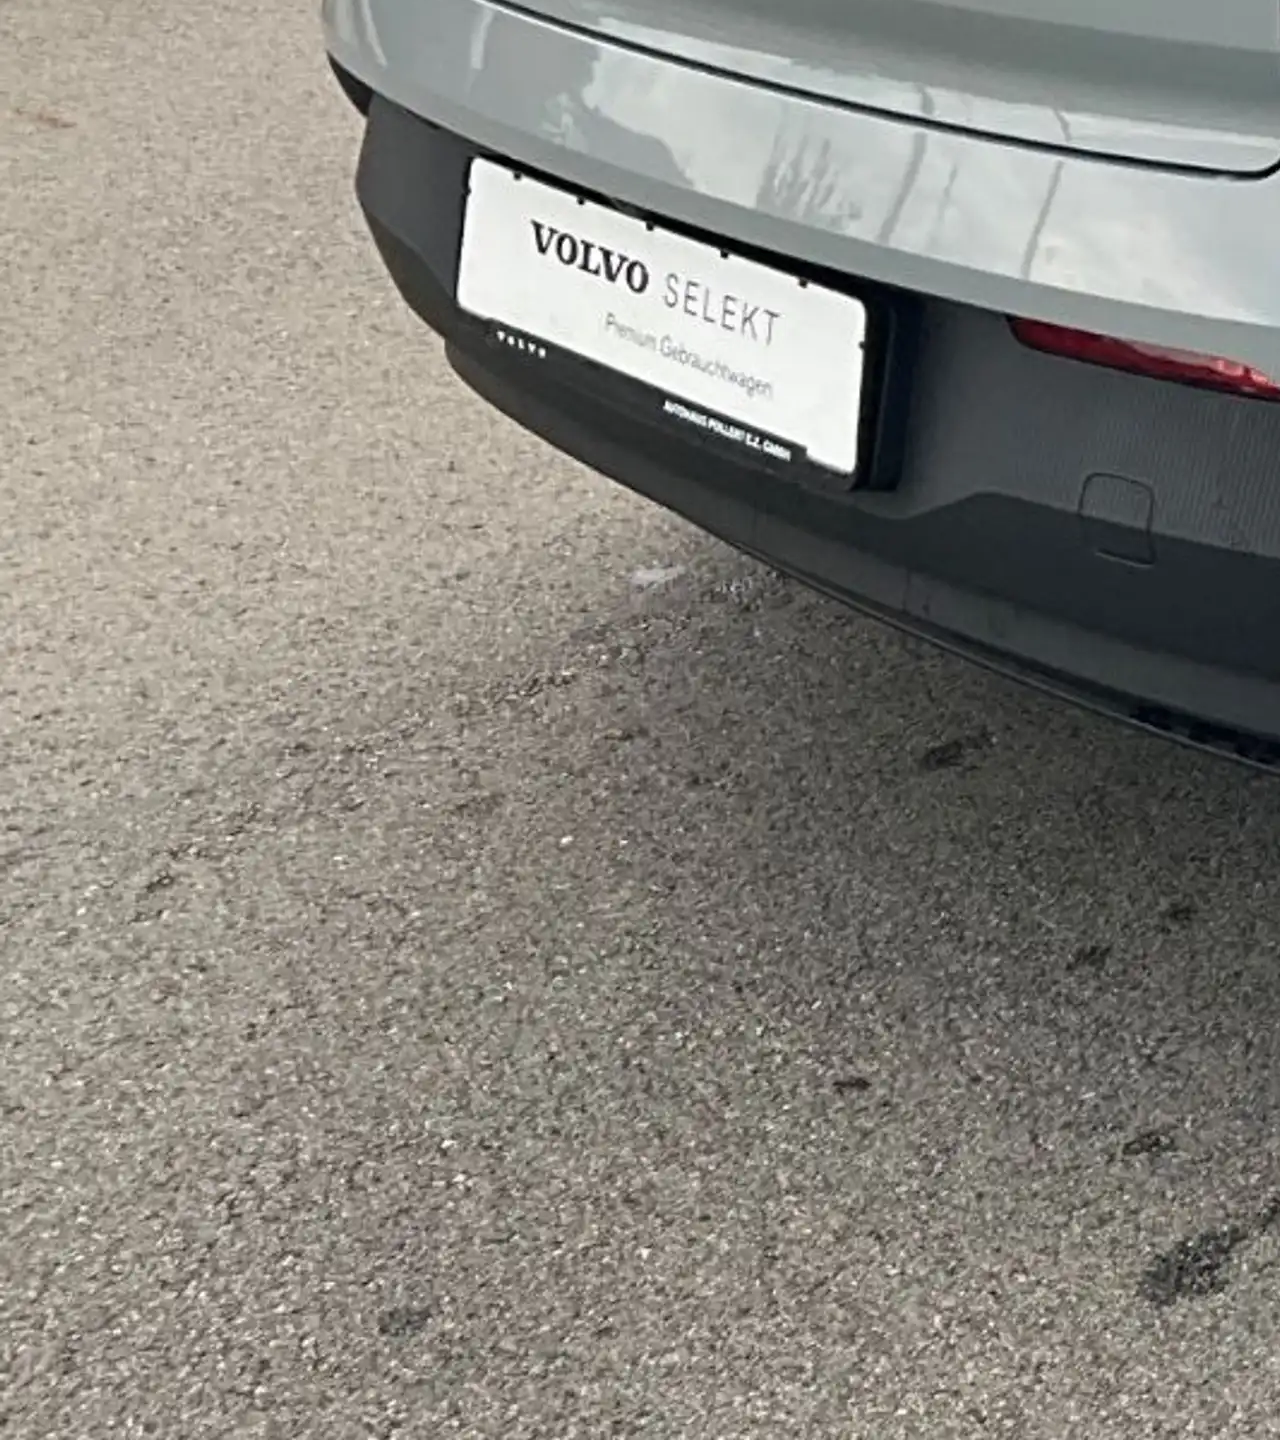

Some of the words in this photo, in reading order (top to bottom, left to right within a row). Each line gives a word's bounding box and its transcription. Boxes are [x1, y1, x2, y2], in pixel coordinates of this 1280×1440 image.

[530, 219, 650, 295] VOLVO
[662, 272, 781, 347] SELEKT
[660, 334, 775, 399] Gebrauchtwagen
